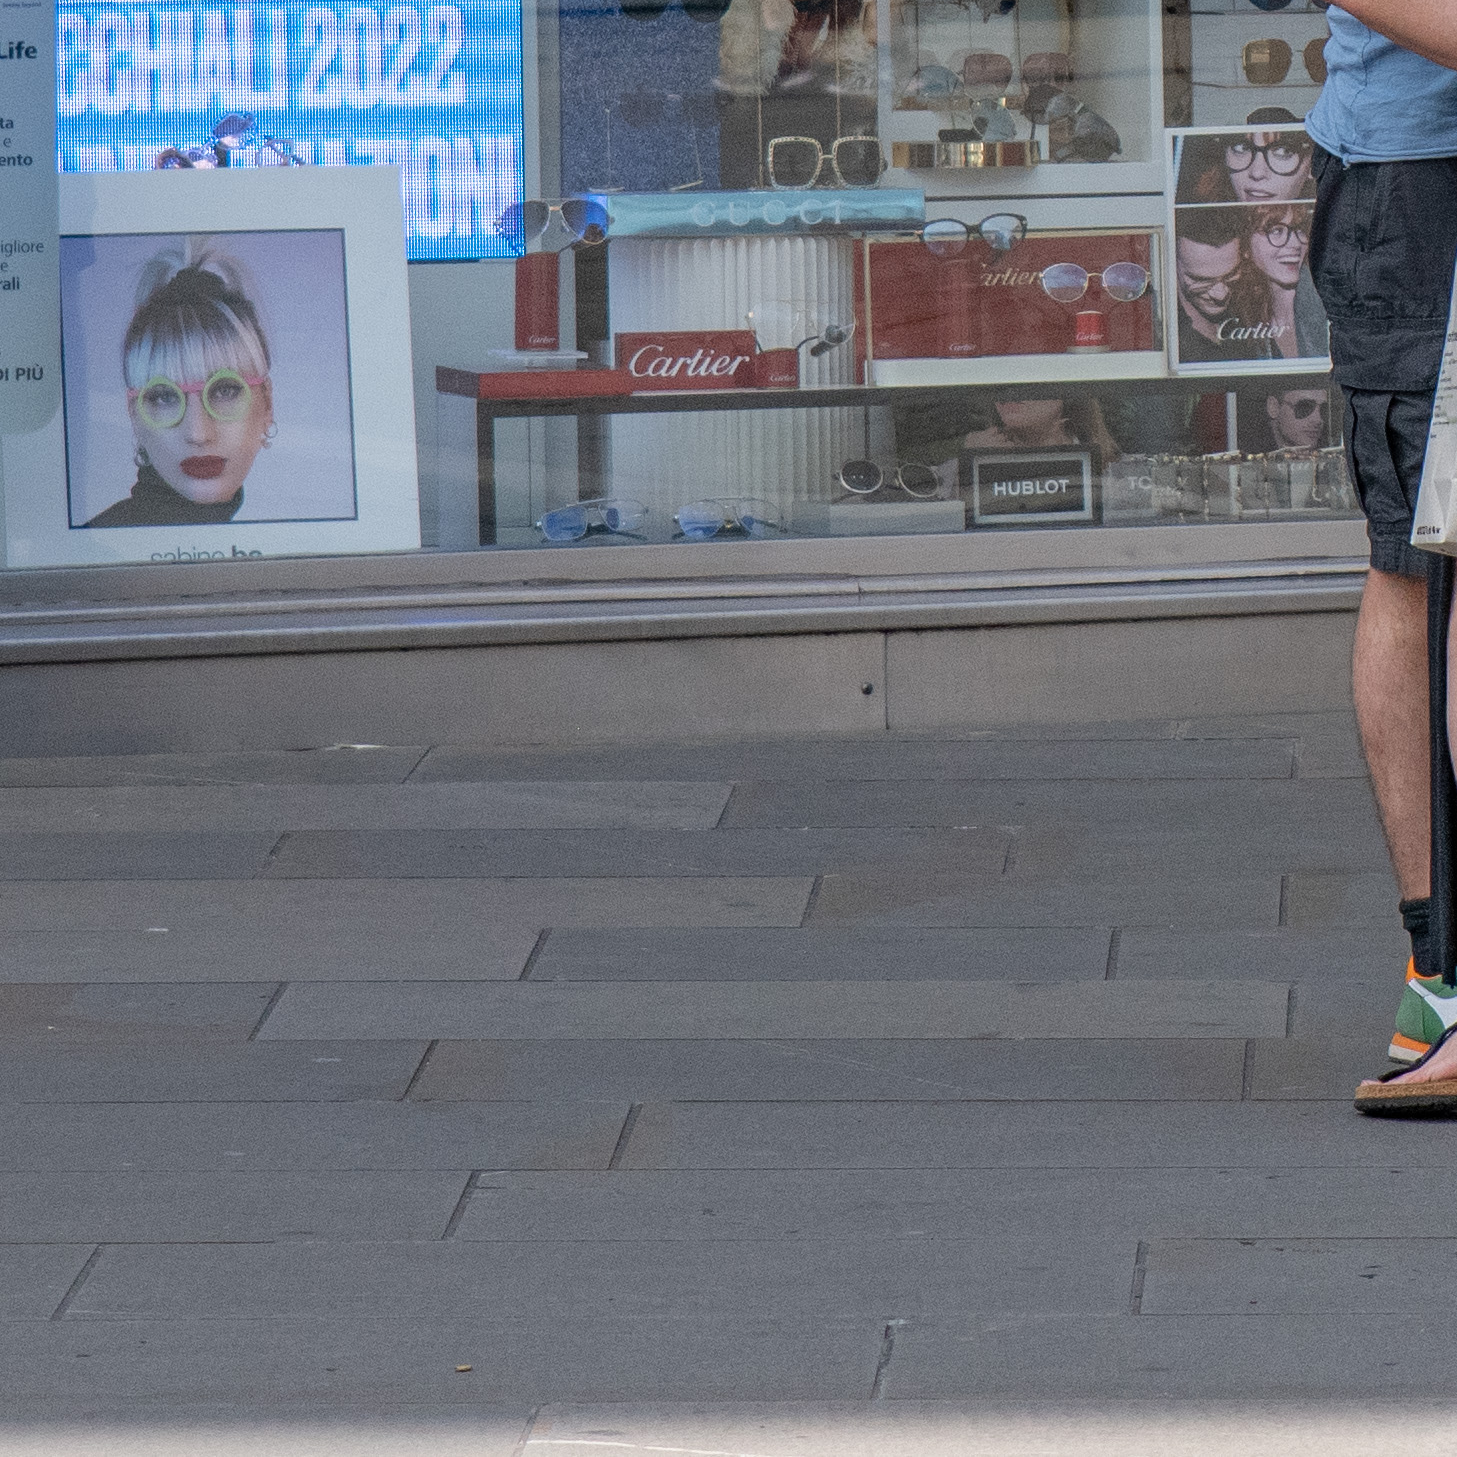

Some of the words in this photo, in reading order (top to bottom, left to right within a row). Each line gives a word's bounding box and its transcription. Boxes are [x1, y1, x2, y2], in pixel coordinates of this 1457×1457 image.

[300, 5, 465, 109] 2022
[691, 198, 843, 227] GUCCI
[980, 264, 1042, 288] artier
[1217, 317, 1294, 341] Cartier
[15, 364, 44, 382] PIÙ
[629, 344, 751, 378] Cartier
[993, 479, 1070, 496] HUBLOT
